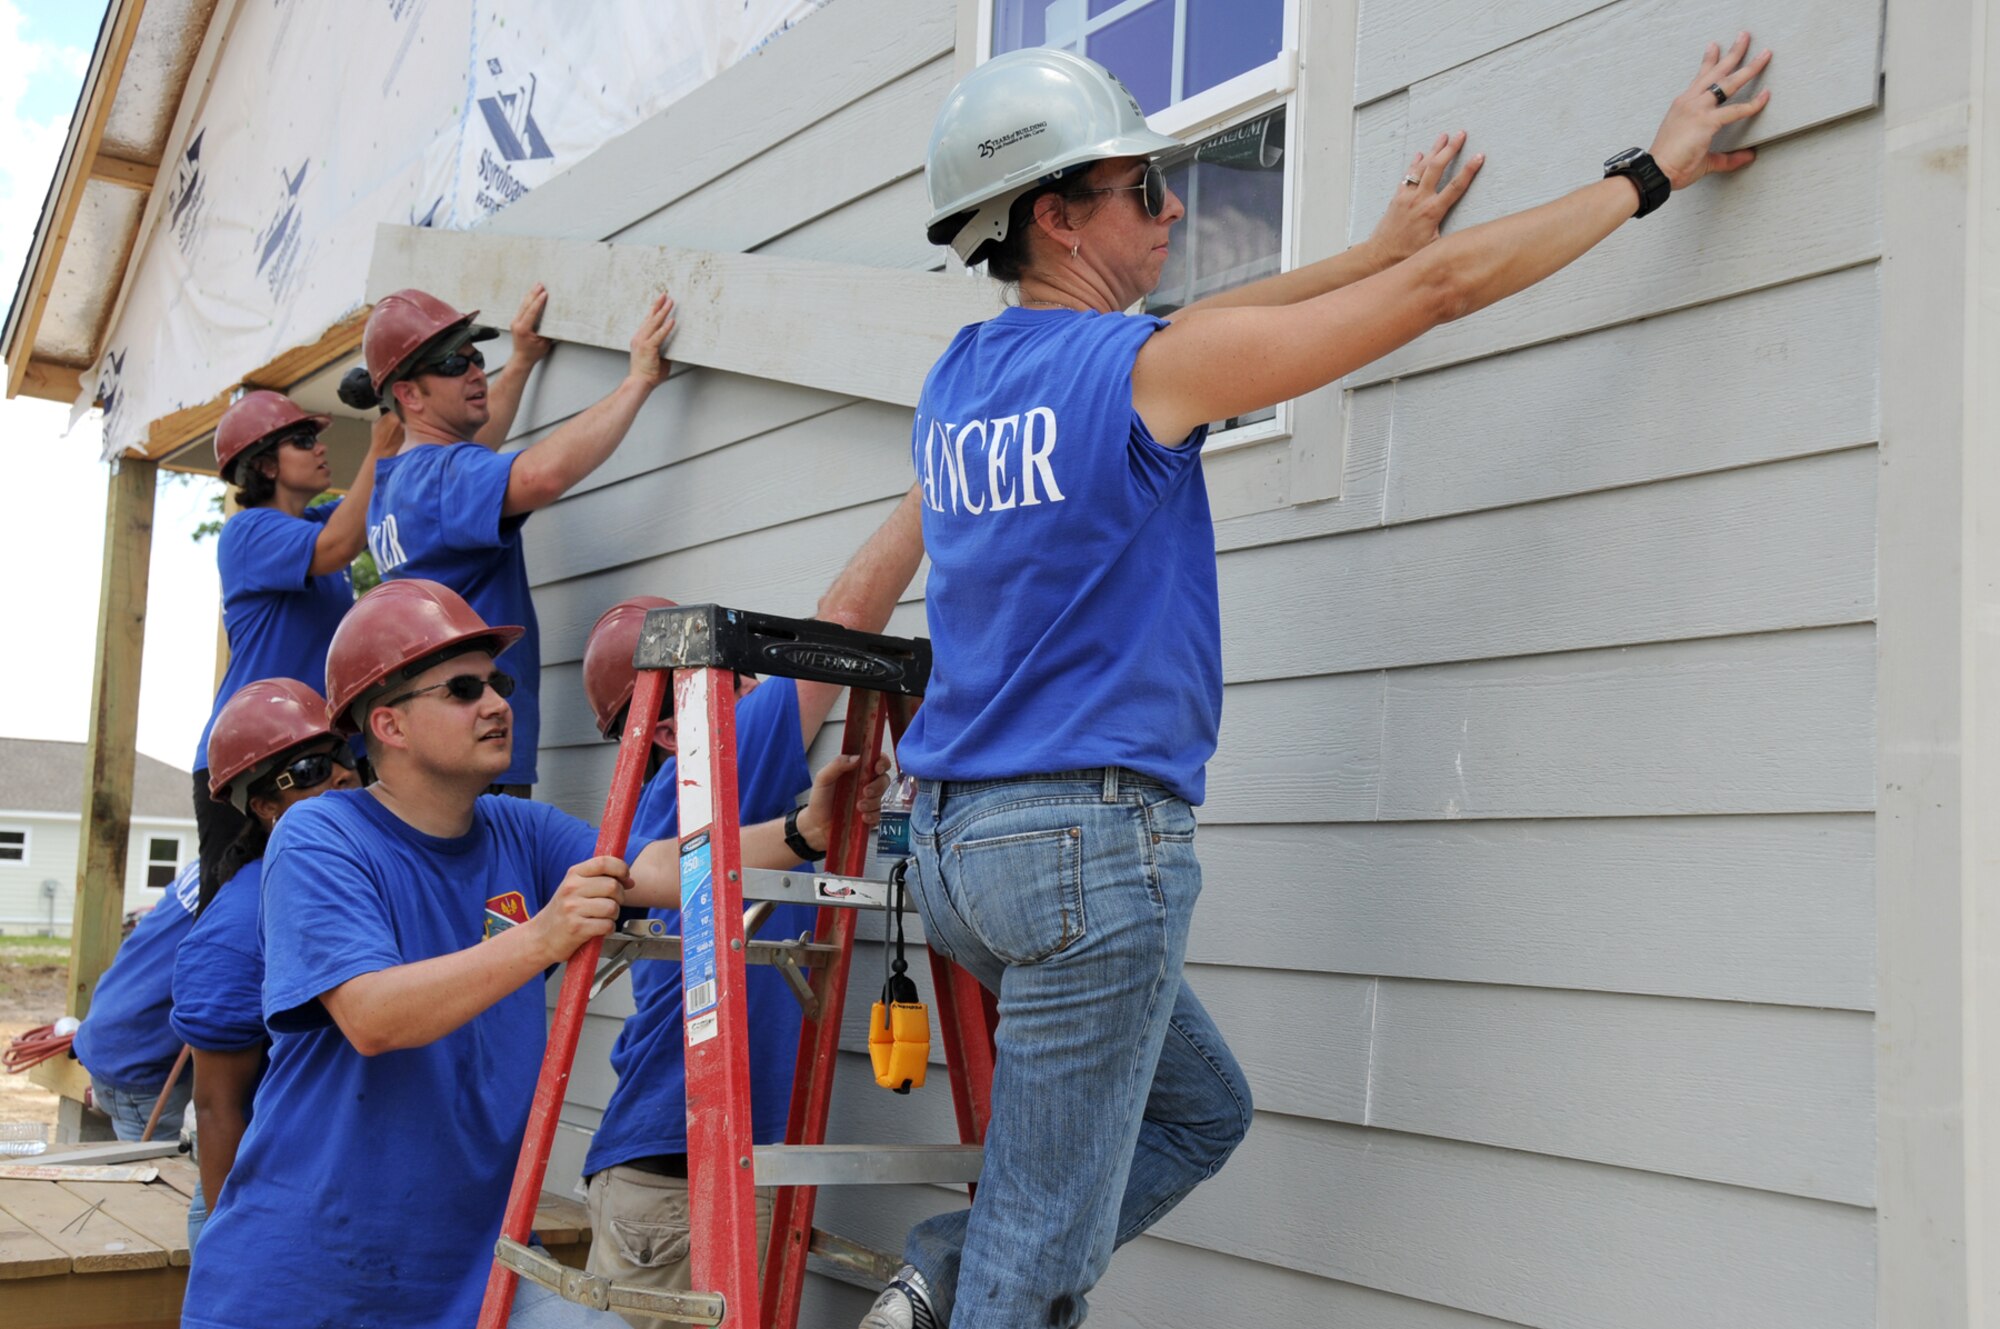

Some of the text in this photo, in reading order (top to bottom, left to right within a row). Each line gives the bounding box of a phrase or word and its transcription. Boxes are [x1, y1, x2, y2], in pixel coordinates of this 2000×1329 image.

[977, 139, 994, 158] 25
[992, 134, 1010, 147] YEARS
[1015, 121, 1047, 137] BUILDING
[792, 650, 876, 672] WERNER
[880, 824, 902, 837] ANI
[683, 856, 700, 875] 250
